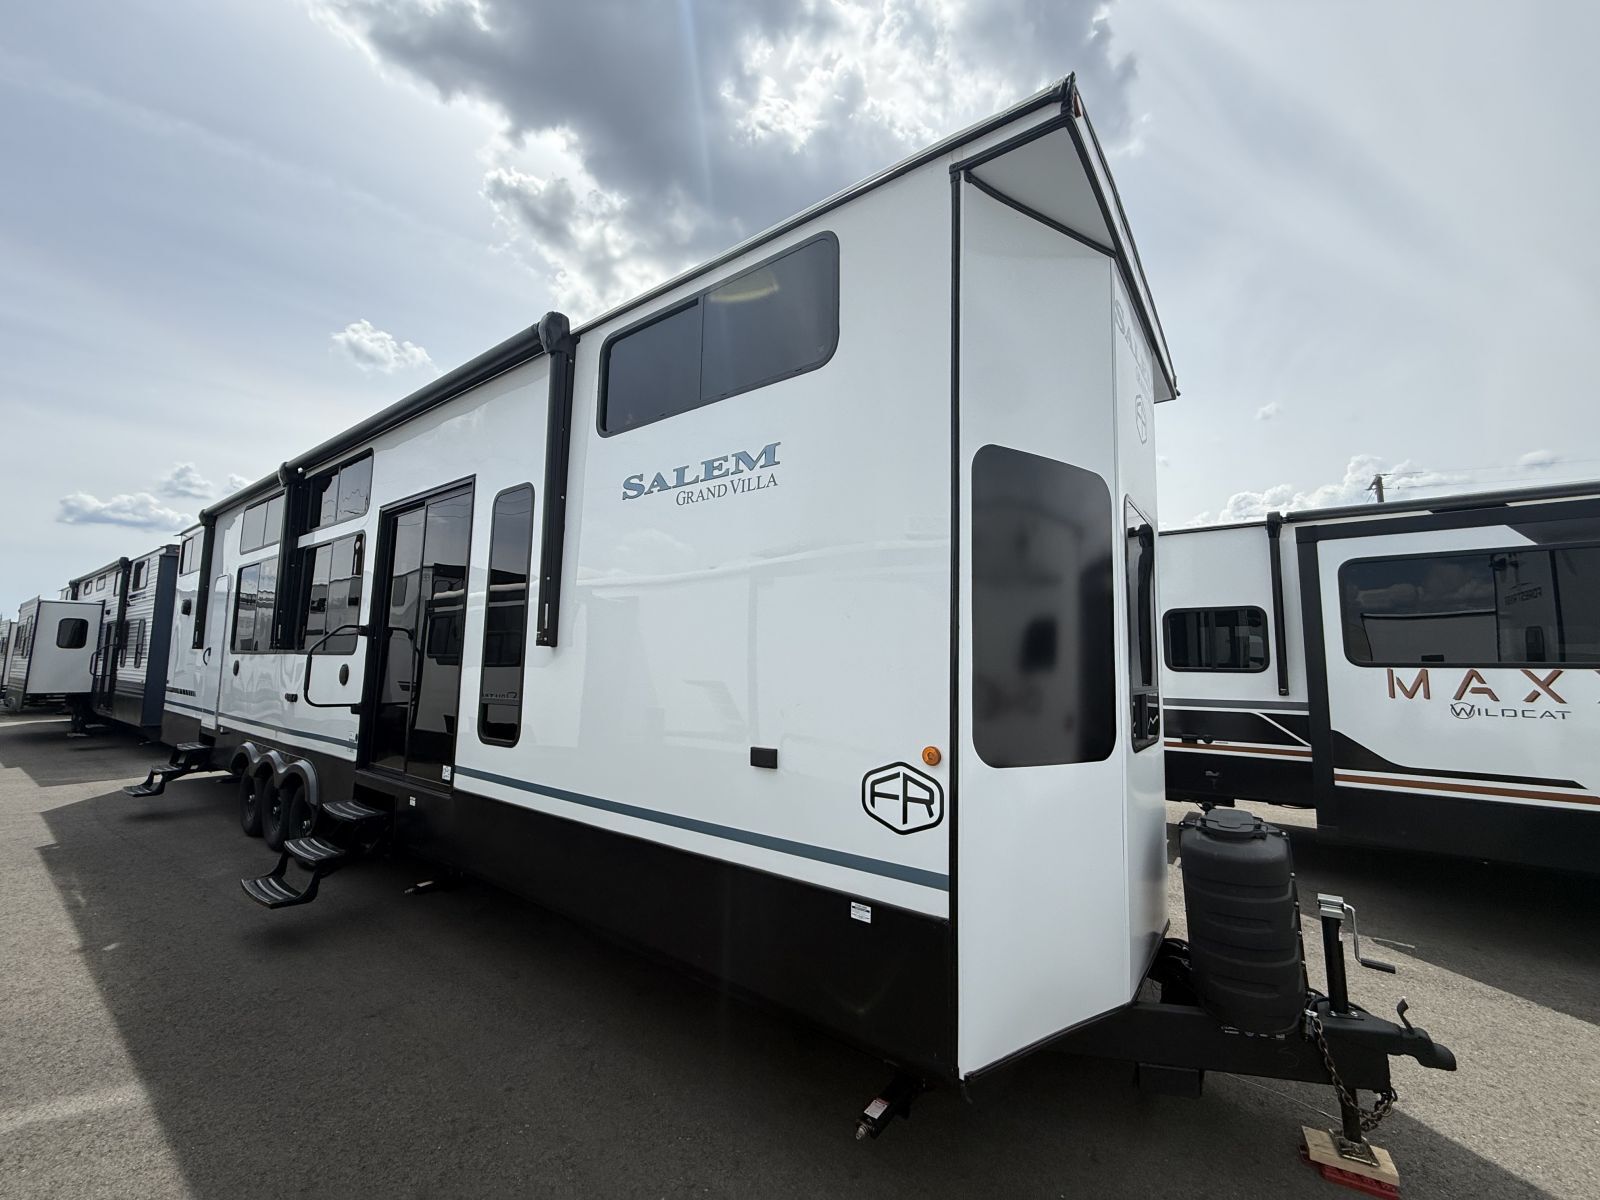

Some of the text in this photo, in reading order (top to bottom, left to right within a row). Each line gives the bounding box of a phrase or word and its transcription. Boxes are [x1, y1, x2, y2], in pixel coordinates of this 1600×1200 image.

[622, 441, 781, 500] SALEM
[676, 472, 778, 506] GRAND VILLA
[1387, 668, 1600, 704] MAX
[1450, 702, 1572, 719] WILDCAT
